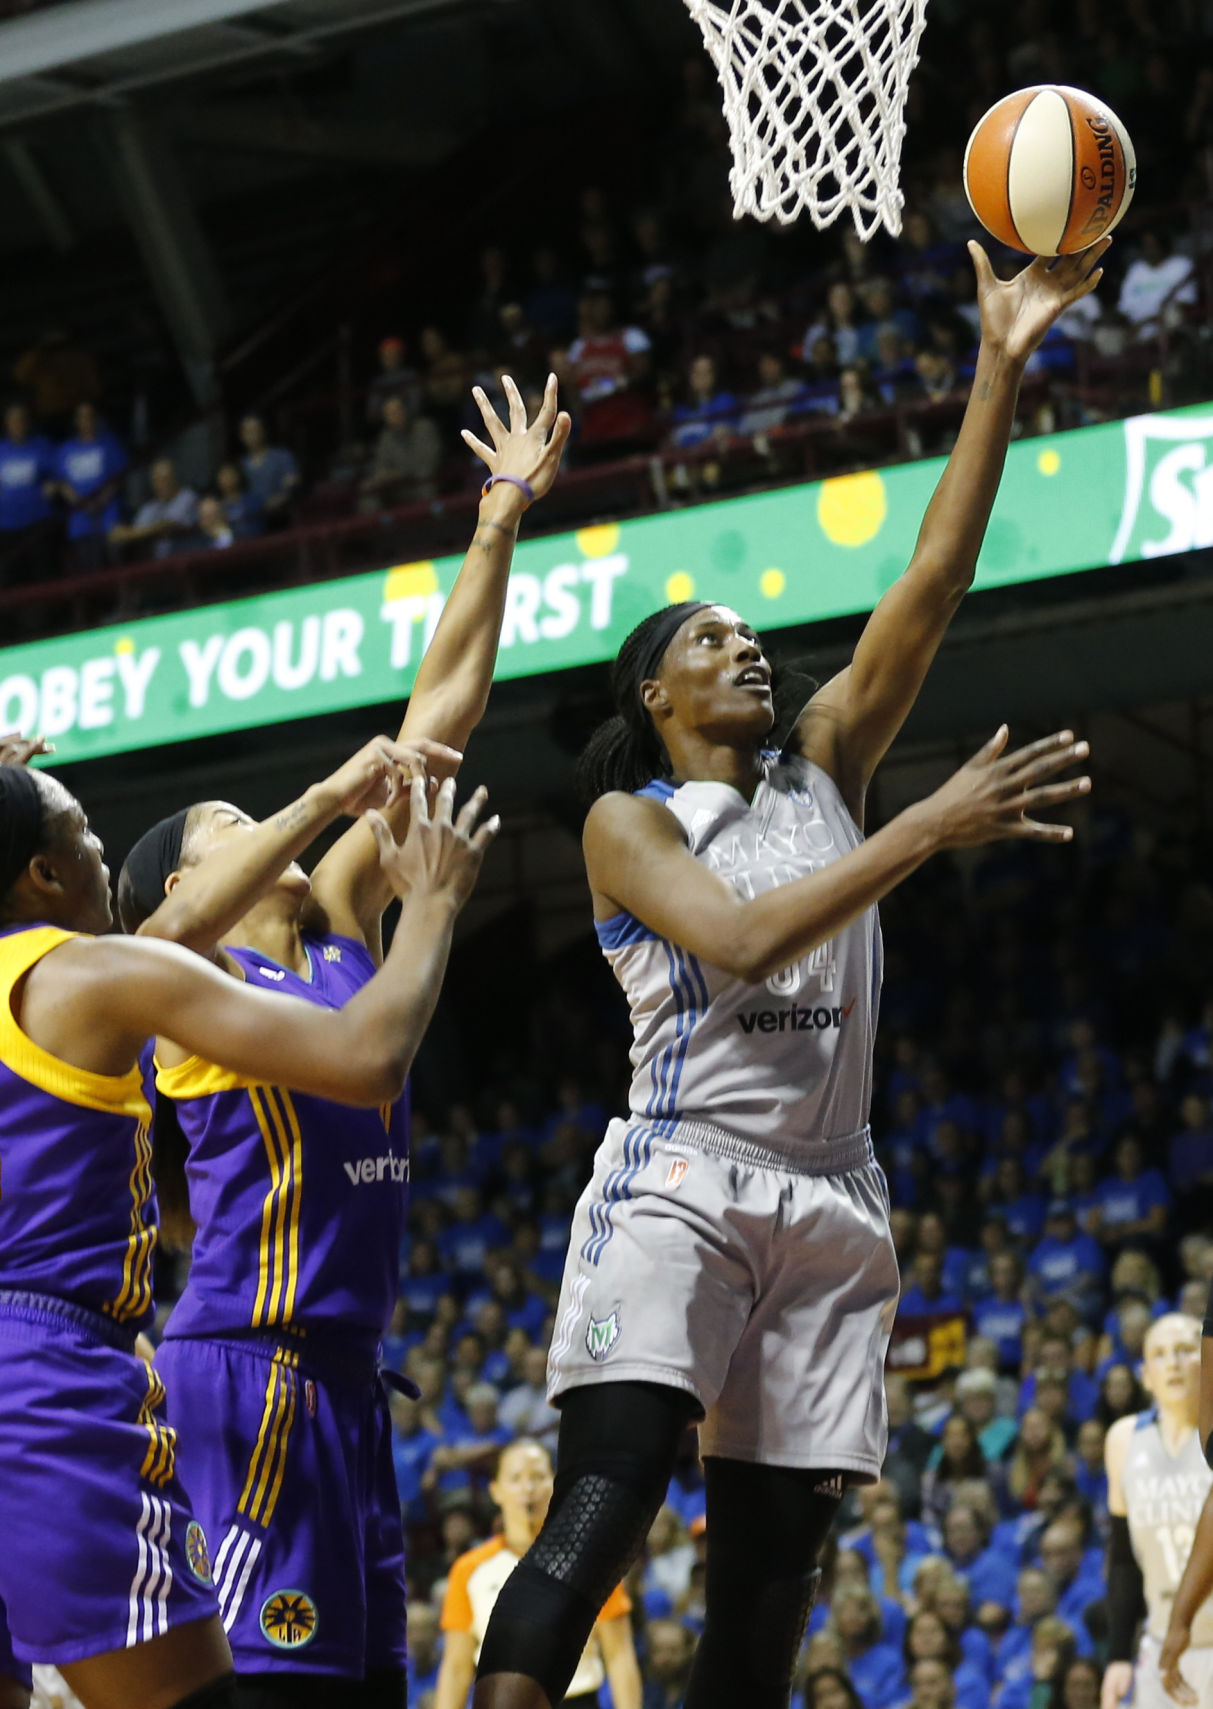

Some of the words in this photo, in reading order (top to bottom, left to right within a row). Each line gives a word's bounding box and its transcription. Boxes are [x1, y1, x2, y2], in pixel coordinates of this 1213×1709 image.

[1082, 113, 1116, 235] SPALDING
[0, 646, 161, 738] OBEY
[180, 609, 363, 708] YOUR
[380, 557, 629, 669] TRST
